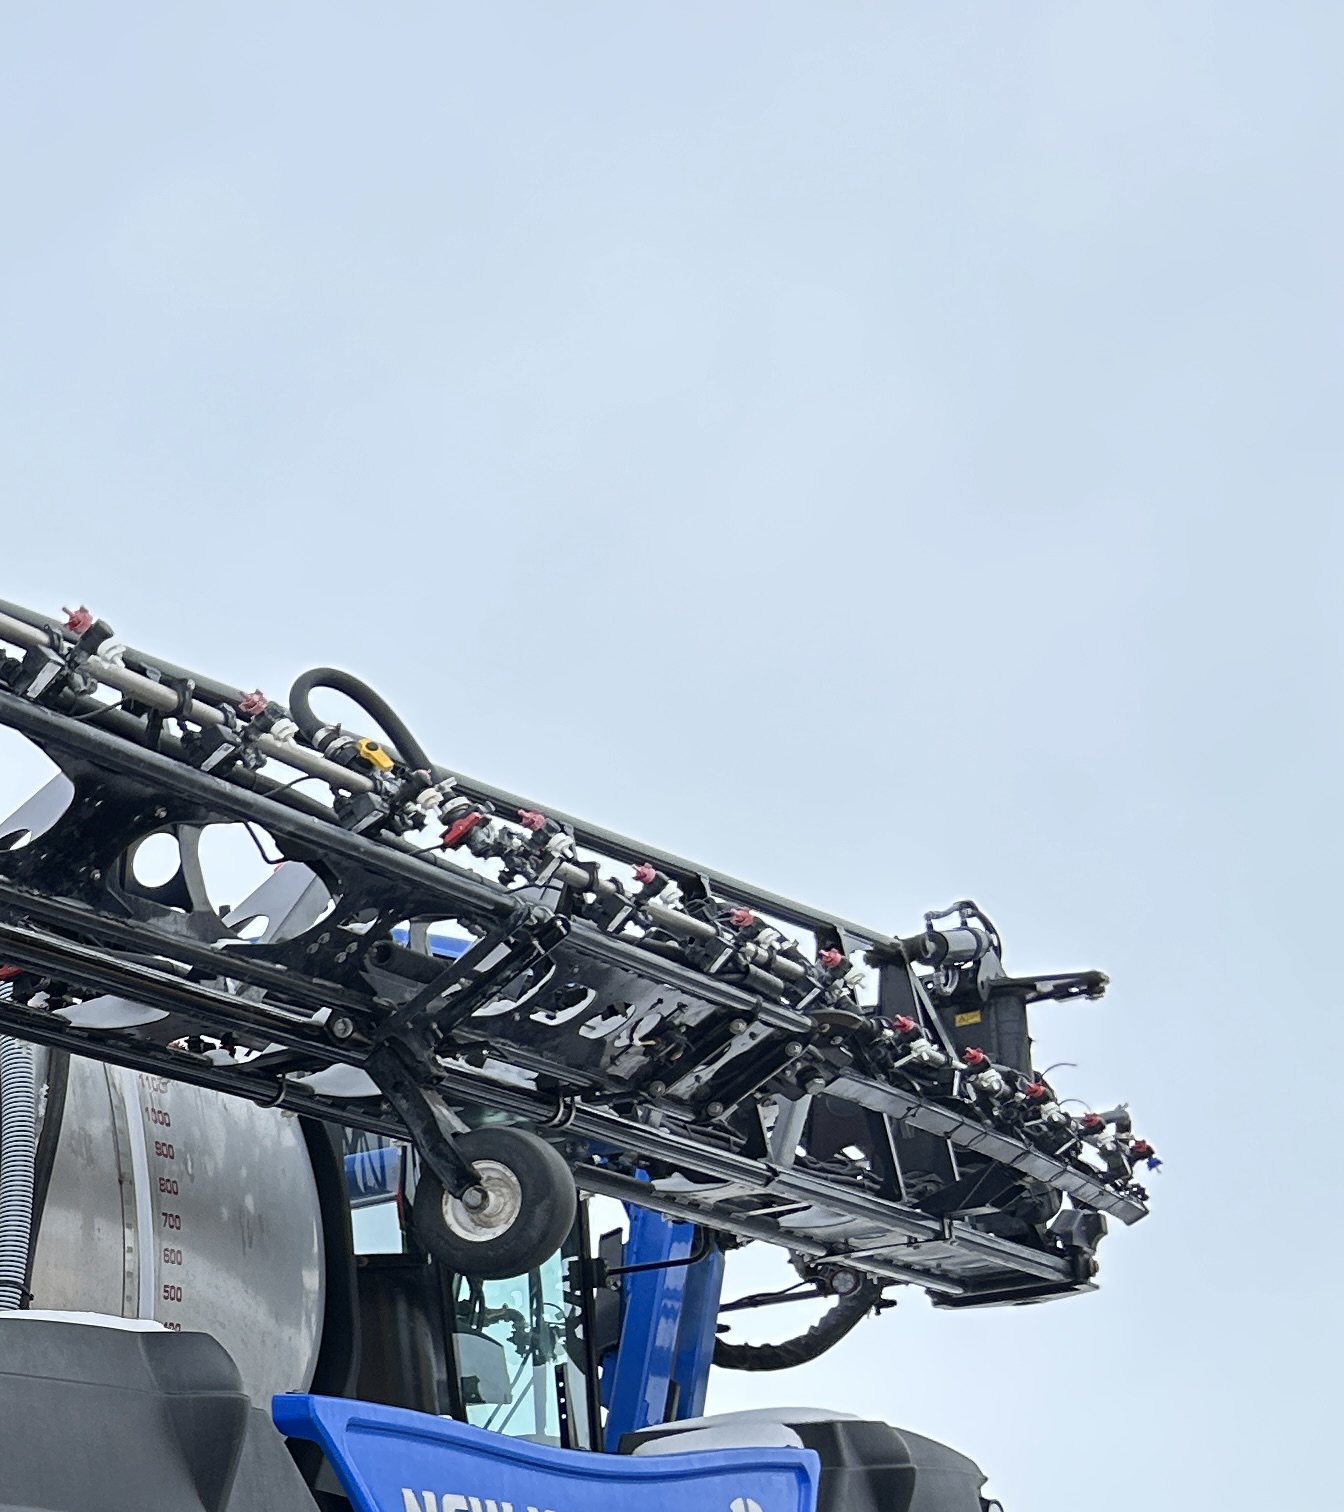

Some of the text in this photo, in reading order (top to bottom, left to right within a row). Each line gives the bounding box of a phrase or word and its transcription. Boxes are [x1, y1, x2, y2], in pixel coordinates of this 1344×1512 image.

[144, 1106, 171, 1128] 1000
[154, 1141, 175, 1160] 900
[158, 1177, 179, 1196] 800
[161, 1212, 182, 1231] 700
[162, 1248, 183, 1267] 600
[162, 1284, 183, 1303] 500
